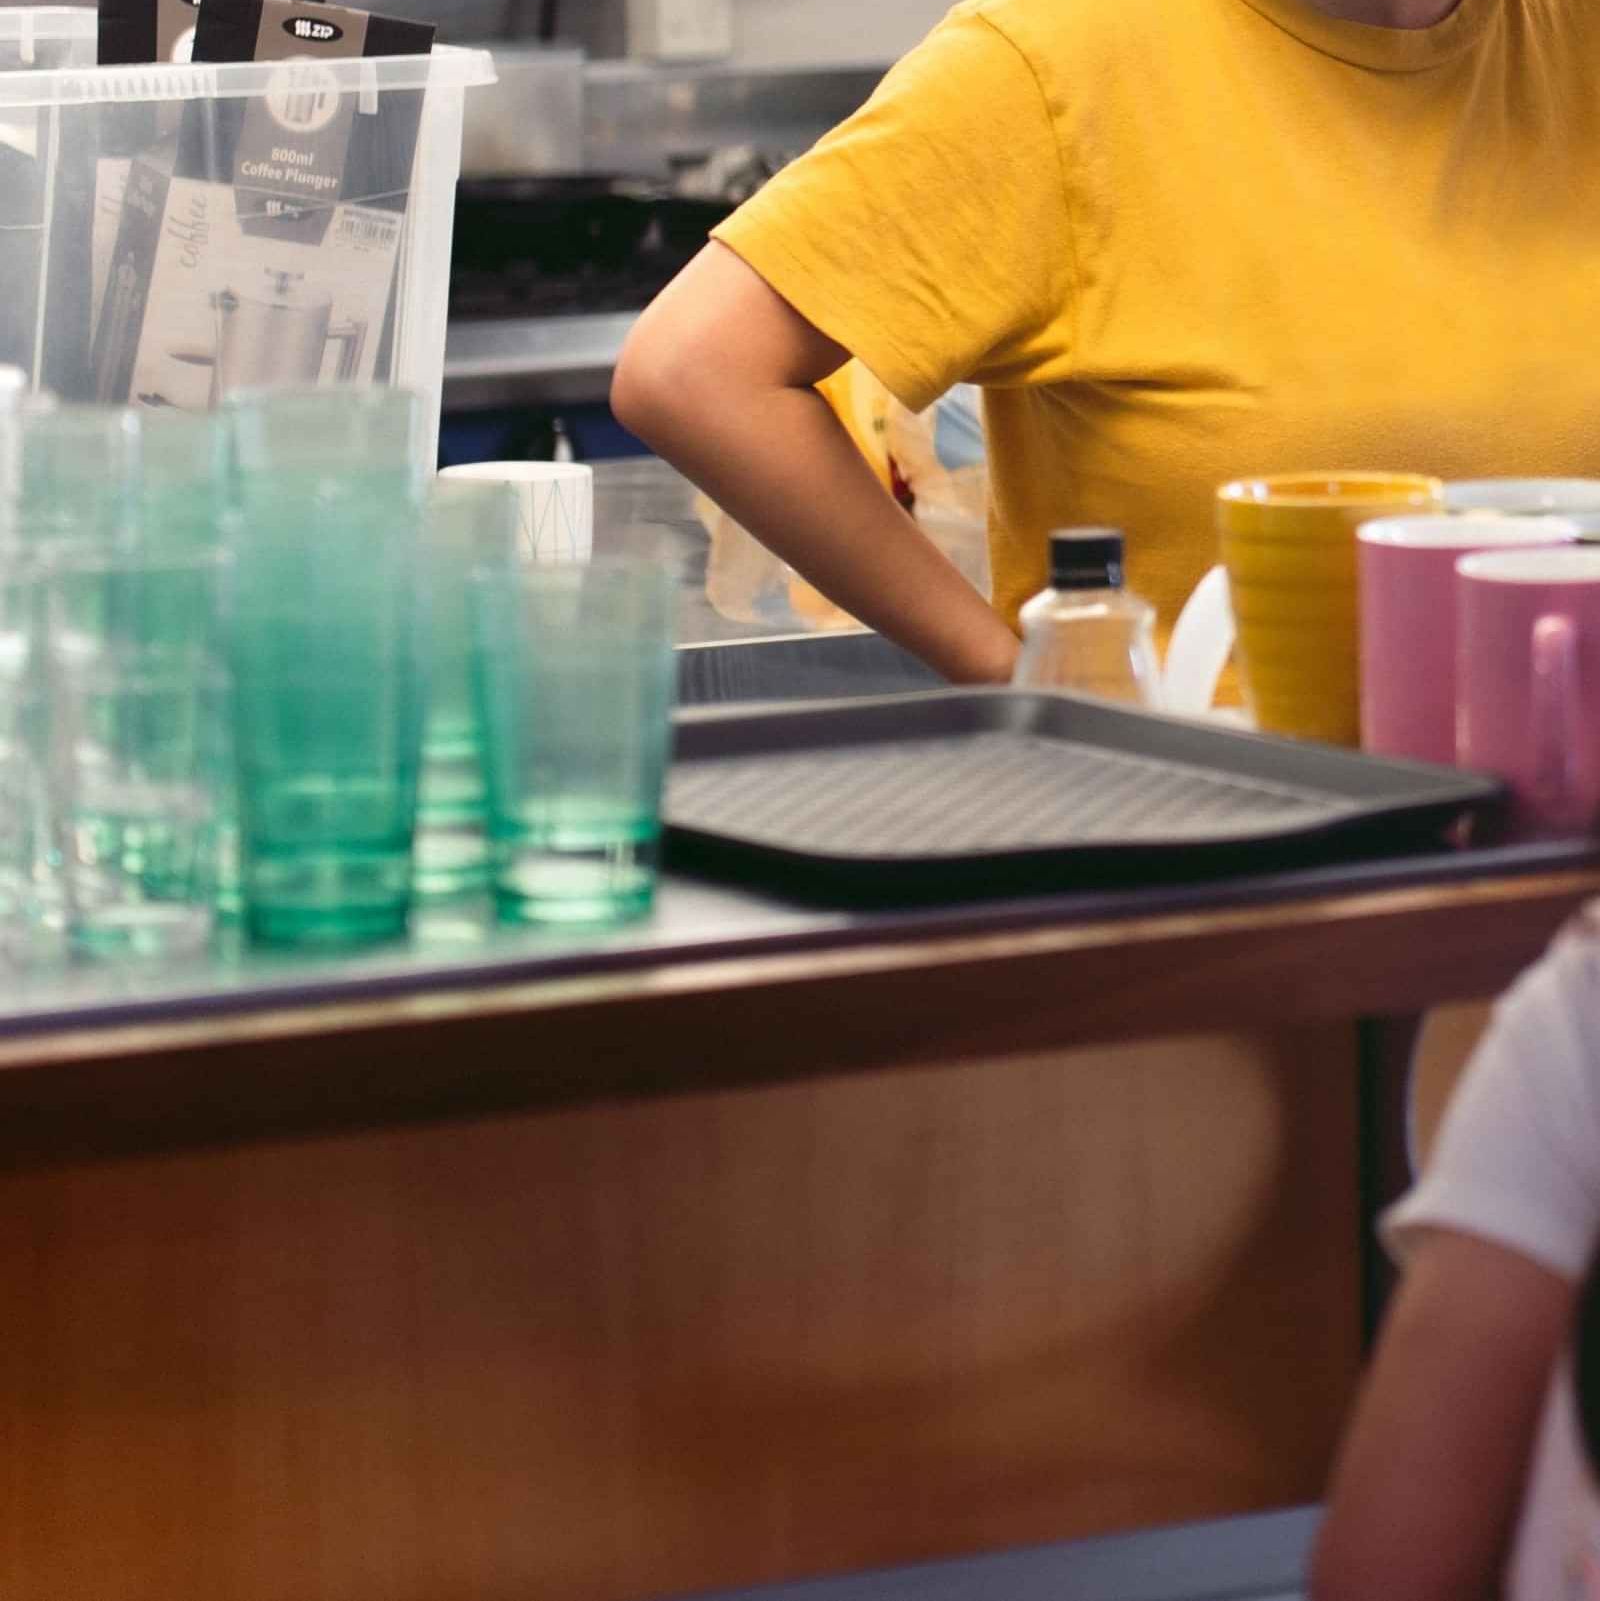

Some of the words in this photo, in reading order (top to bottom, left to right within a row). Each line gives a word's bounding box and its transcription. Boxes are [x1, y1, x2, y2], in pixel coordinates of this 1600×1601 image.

[311, 25, 334, 39] ZIP
[271, 148, 314, 166] 800ml
[241, 161, 282, 179] Coffee
[285, 168, 338, 190] Plunger
